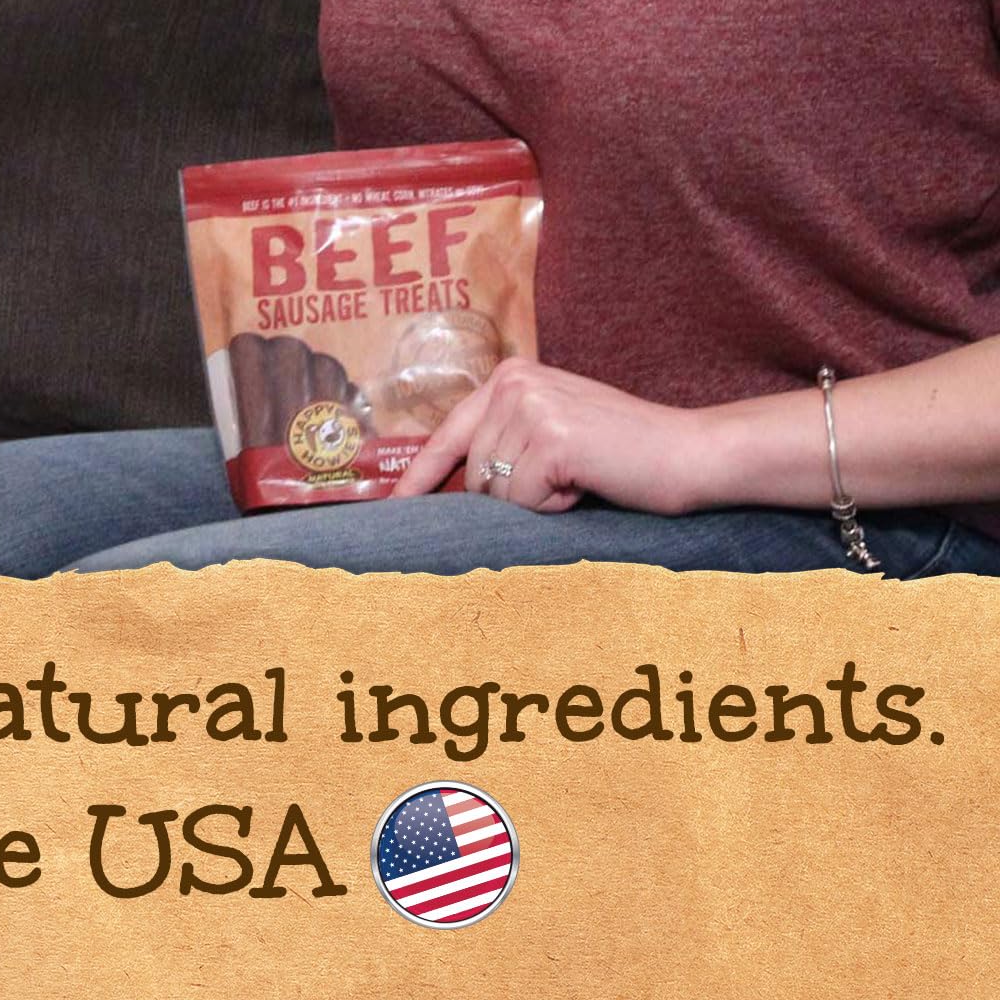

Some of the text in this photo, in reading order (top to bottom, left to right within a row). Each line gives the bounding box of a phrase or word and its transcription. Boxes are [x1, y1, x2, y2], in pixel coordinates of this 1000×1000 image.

[251, 206, 475, 298] BEEF
[257, 279, 471, 330] SAUSAGE TREATS
[293, 404, 335, 445] HAPPY
